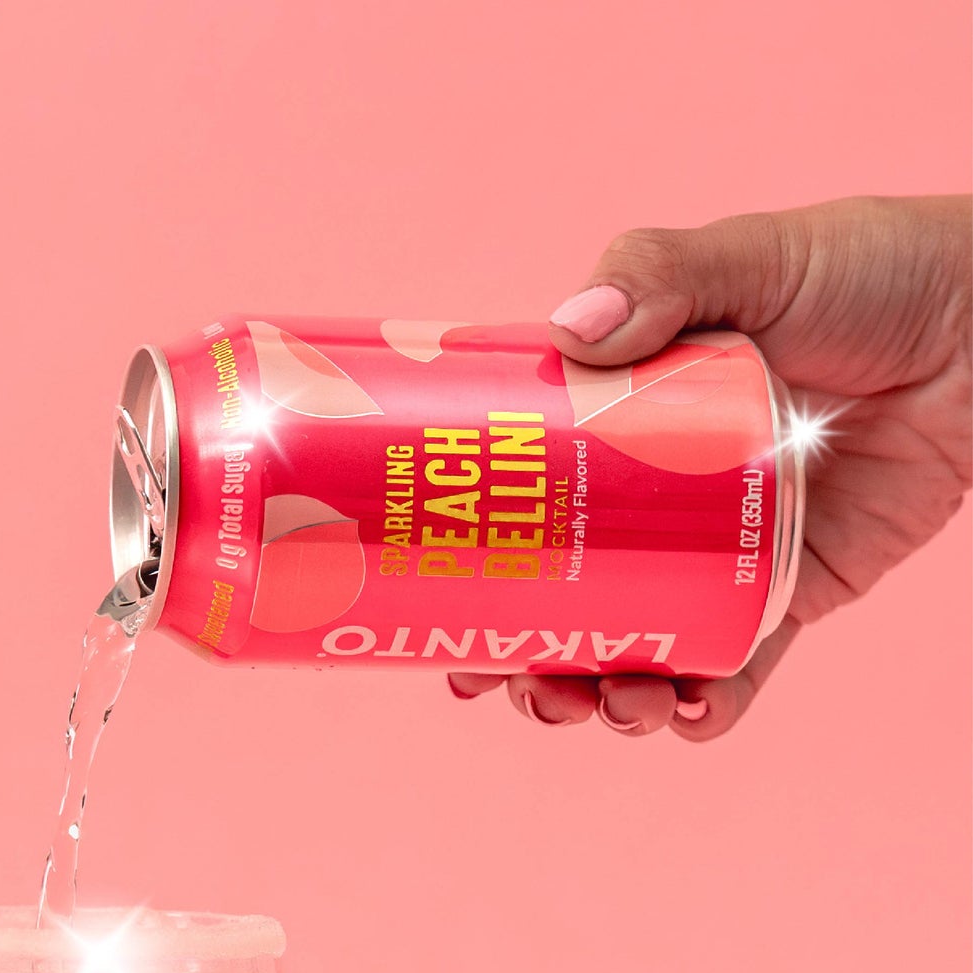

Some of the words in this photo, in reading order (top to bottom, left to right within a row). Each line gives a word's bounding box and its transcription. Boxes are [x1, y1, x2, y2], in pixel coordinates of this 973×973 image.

[208, 338, 242, 429] Non-Alcoholic
[417, 427, 482, 578] PEACH
[482, 411, 547, 580] BELLINI
[572, 440, 588, 507] Flavored
[741, 469, 765, 527] (350mL)
[218, 498, 244, 540] Total
[379, 445, 415, 577] SPARKLING
[546, 476, 569, 581] MOCKTAIL
[740, 529, 761, 548] OZ
[216, 557, 239, 570] 0
[220, 543, 247, 557] g
[566, 511, 589, 581] Naturally
[737, 550, 759, 567] FL
[735, 570, 756, 585] 12
[321, 625, 677, 663] LAKANTO
